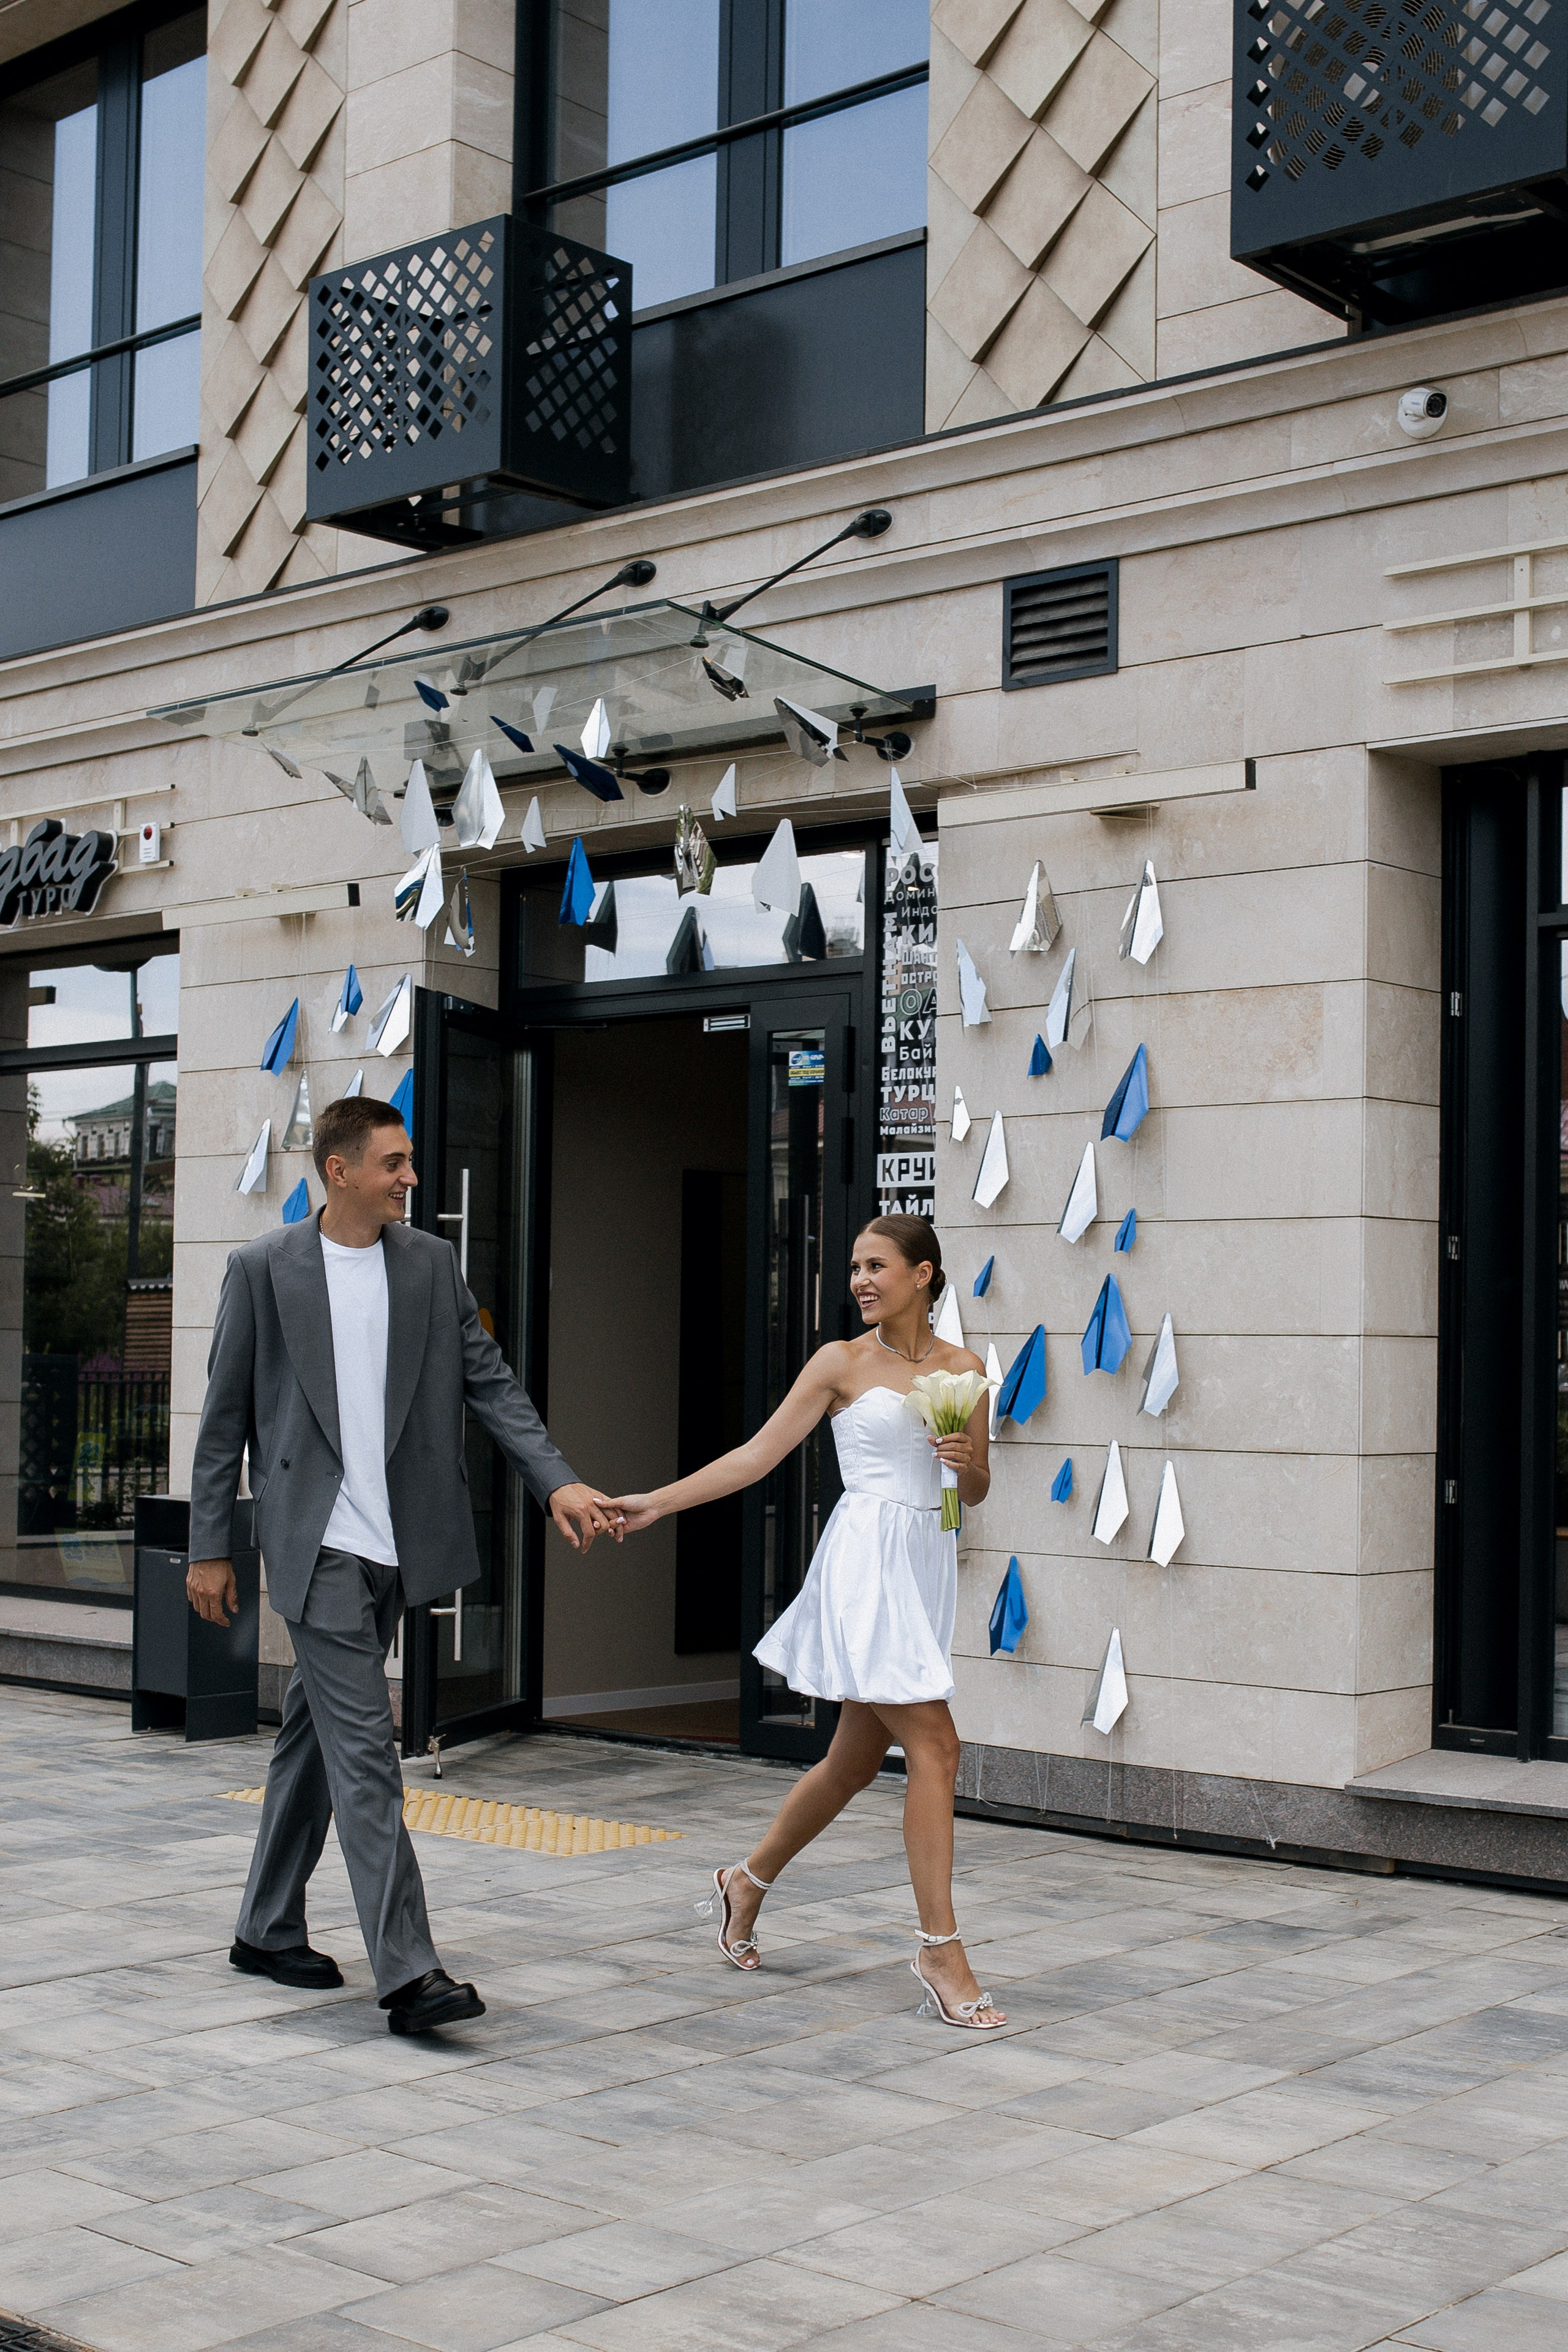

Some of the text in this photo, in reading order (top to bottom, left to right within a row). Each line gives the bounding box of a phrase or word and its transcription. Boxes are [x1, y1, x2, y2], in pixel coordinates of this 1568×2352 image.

[885, 862, 935, 888] РОС
[901, 922, 933, 945] КИ
[881, 912, 898, 1053] ВЬЕТНАМ
[899, 1019, 937, 1041] КУ
[899, 1043, 937, 1060] Бай
[880, 1084, 935, 1103] ТУРЦ
[880, 1107, 929, 1121] Катар
[878, 1194, 934, 1216] ТАЙЛ
